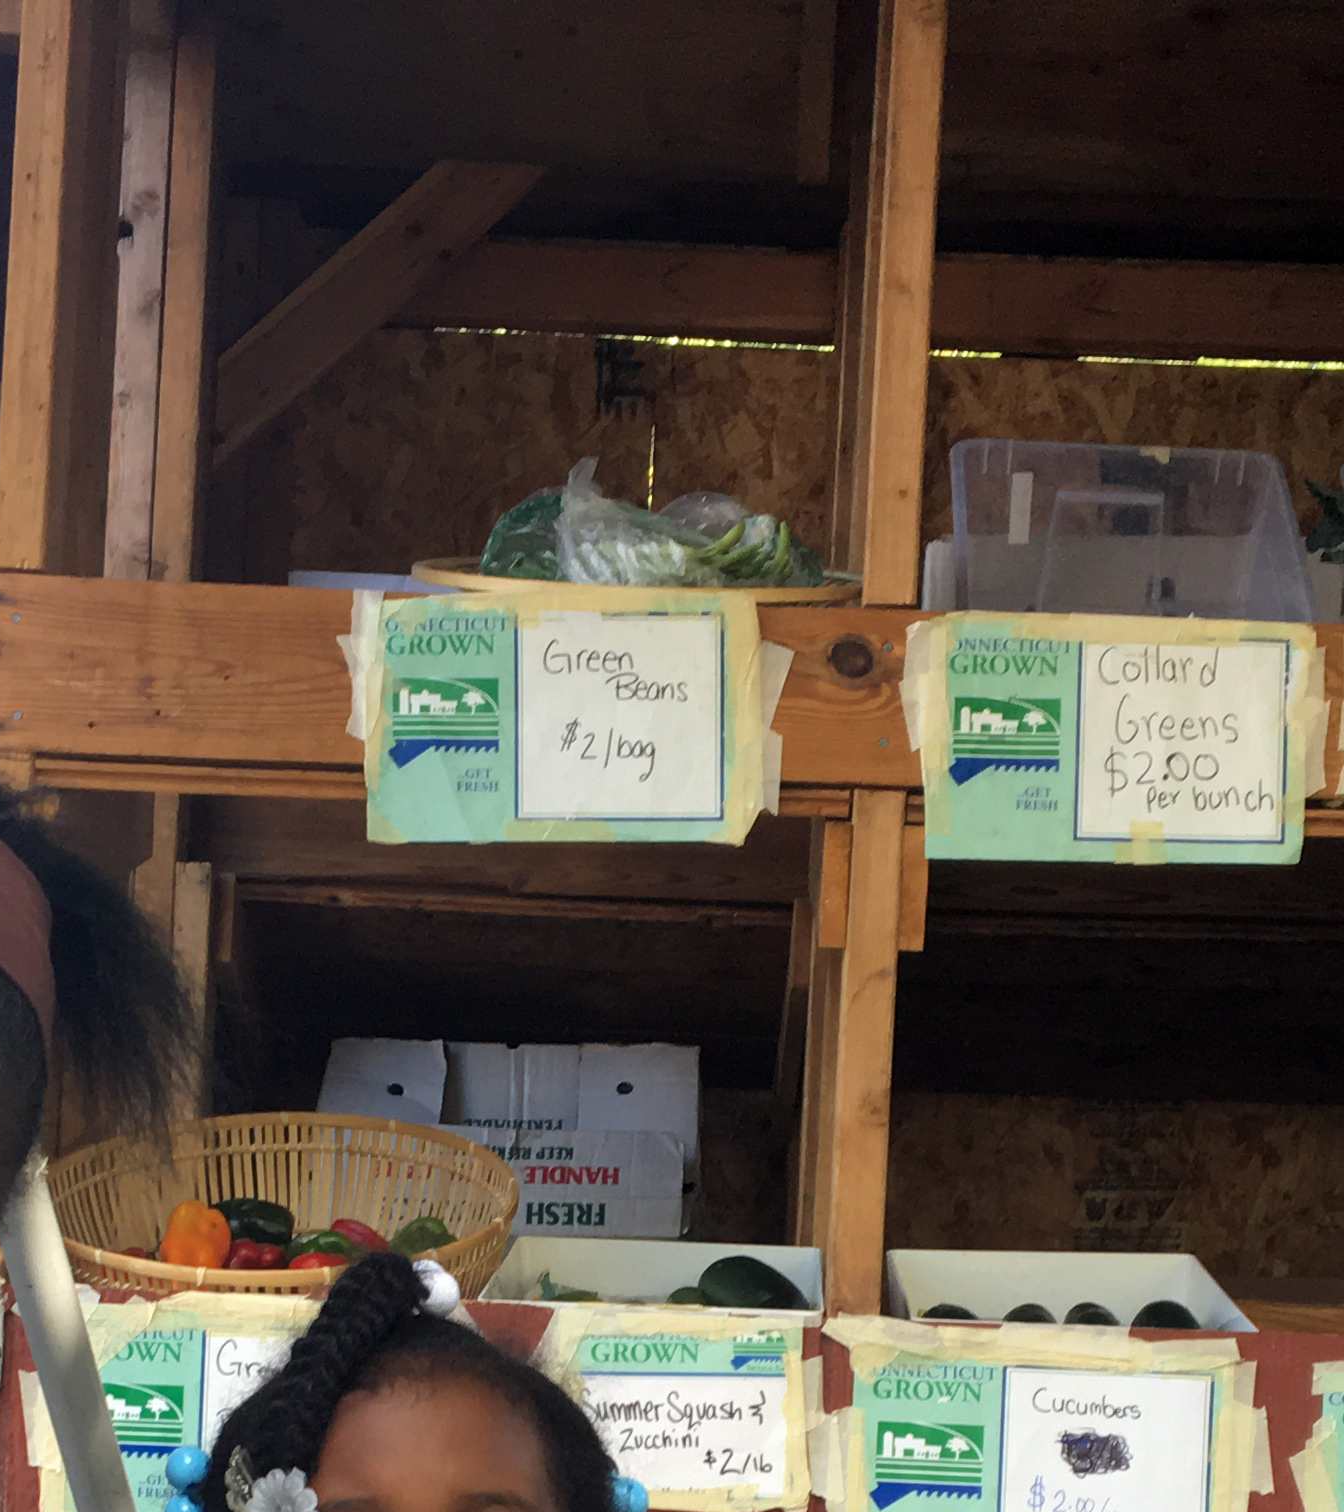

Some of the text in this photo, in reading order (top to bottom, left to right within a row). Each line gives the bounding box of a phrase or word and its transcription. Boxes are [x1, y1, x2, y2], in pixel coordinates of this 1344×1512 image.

[386, 633, 496, 656] GROWN
[543, 638, 634, 675] Green
[949, 653, 1059, 676] GROWN
[1098, 645, 1219, 688] Collard
[605, 672, 689, 702] Beans
[1114, 692, 1240, 745] Greens
[1104, 751, 1220, 797] $2.00
[1191, 778, 1276, 813] bunch
[537, 1146, 574, 1161] KEEP
[524, 1166, 621, 1186] HANDLE
[525, 1201, 607, 1227] FRESH
[591, 1342, 700, 1365] GROWN
[873, 1378, 983, 1403] GROWN
[1032, 1387, 1142, 1420] Cucumbers
[582, 1387, 661, 1424] Summer
[666, 1390, 742, 1430] Squash
[619, 1427, 701, 1453] Zucchini
